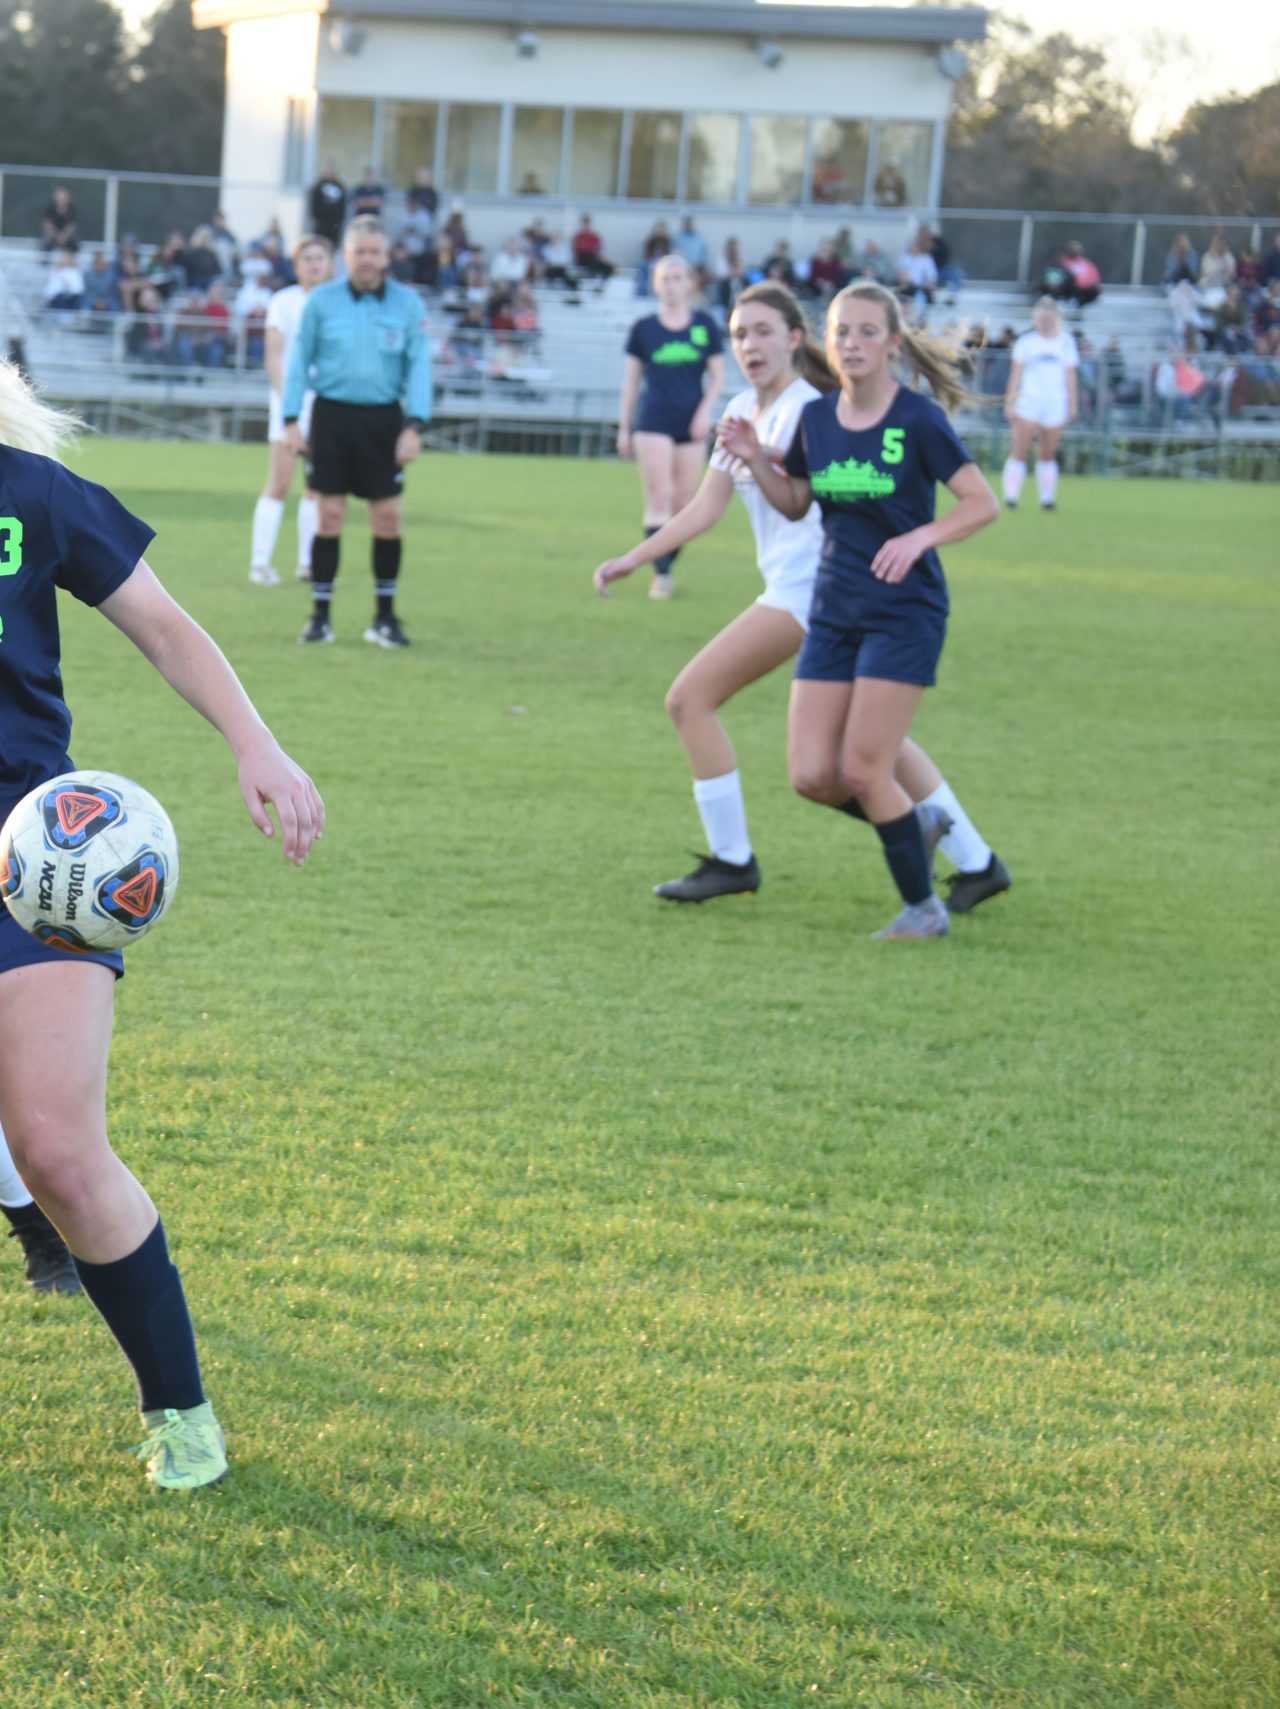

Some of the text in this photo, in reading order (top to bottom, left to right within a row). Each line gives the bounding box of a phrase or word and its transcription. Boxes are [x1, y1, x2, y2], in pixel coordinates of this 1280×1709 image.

[880, 427, 906, 465] 5
[38, 860, 57, 912] NCAA
[65, 861, 87, 922] Wilson
